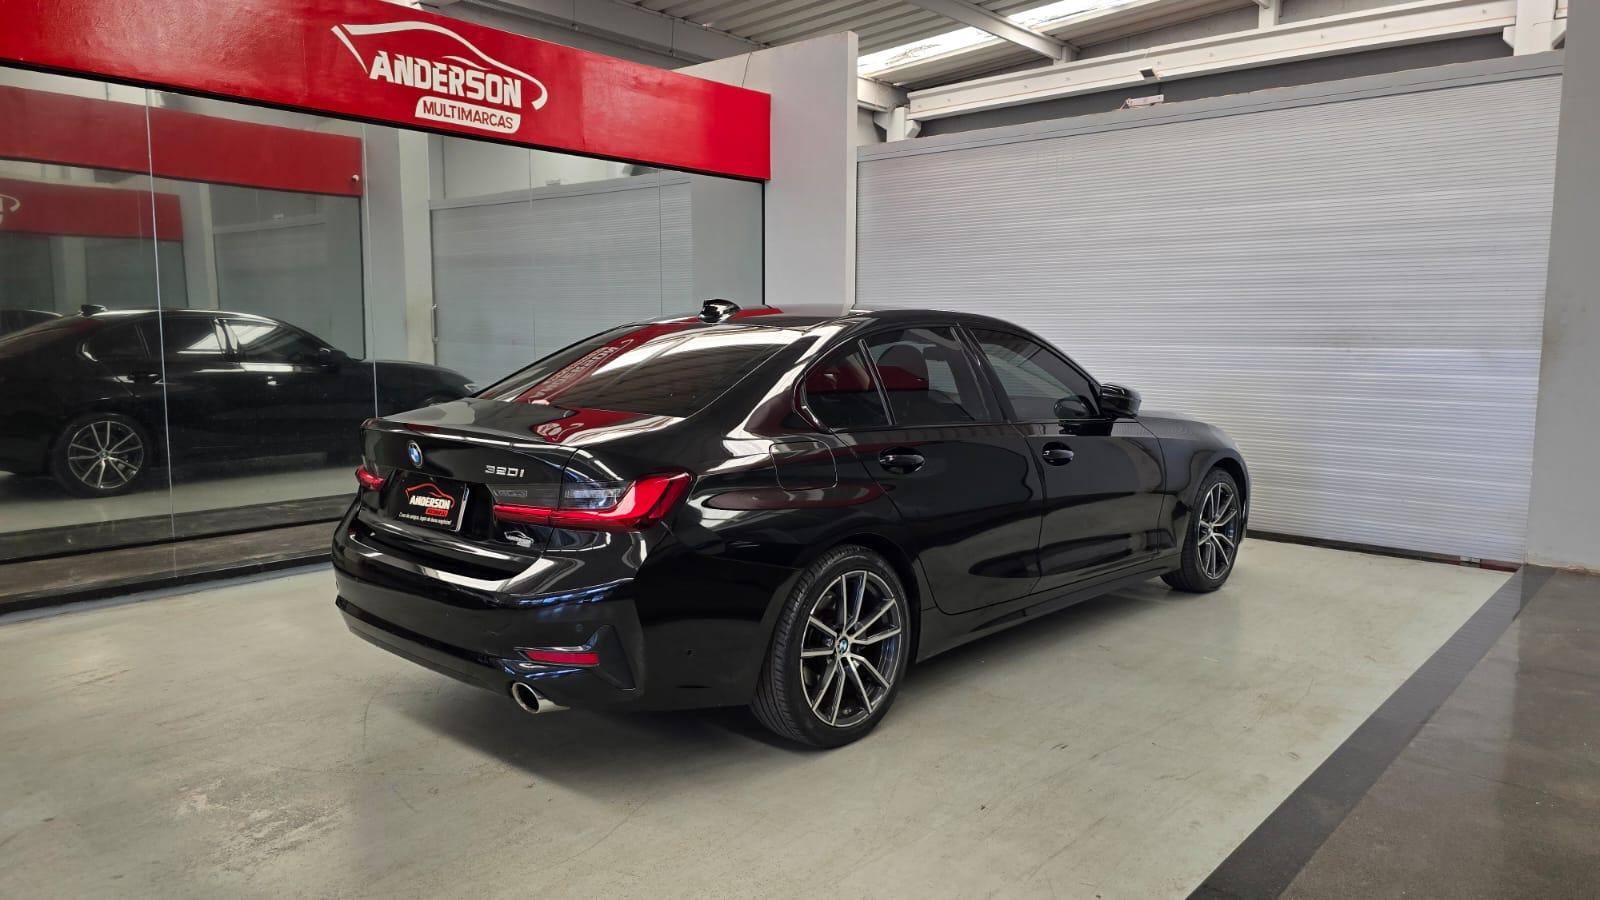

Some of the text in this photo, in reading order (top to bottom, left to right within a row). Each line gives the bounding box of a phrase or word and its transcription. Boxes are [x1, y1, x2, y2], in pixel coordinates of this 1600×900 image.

[370, 51, 522, 109] ANDERSON
[423, 100, 513, 129] MULTIMARCAS
[409, 495, 451, 510] ANDERSON
